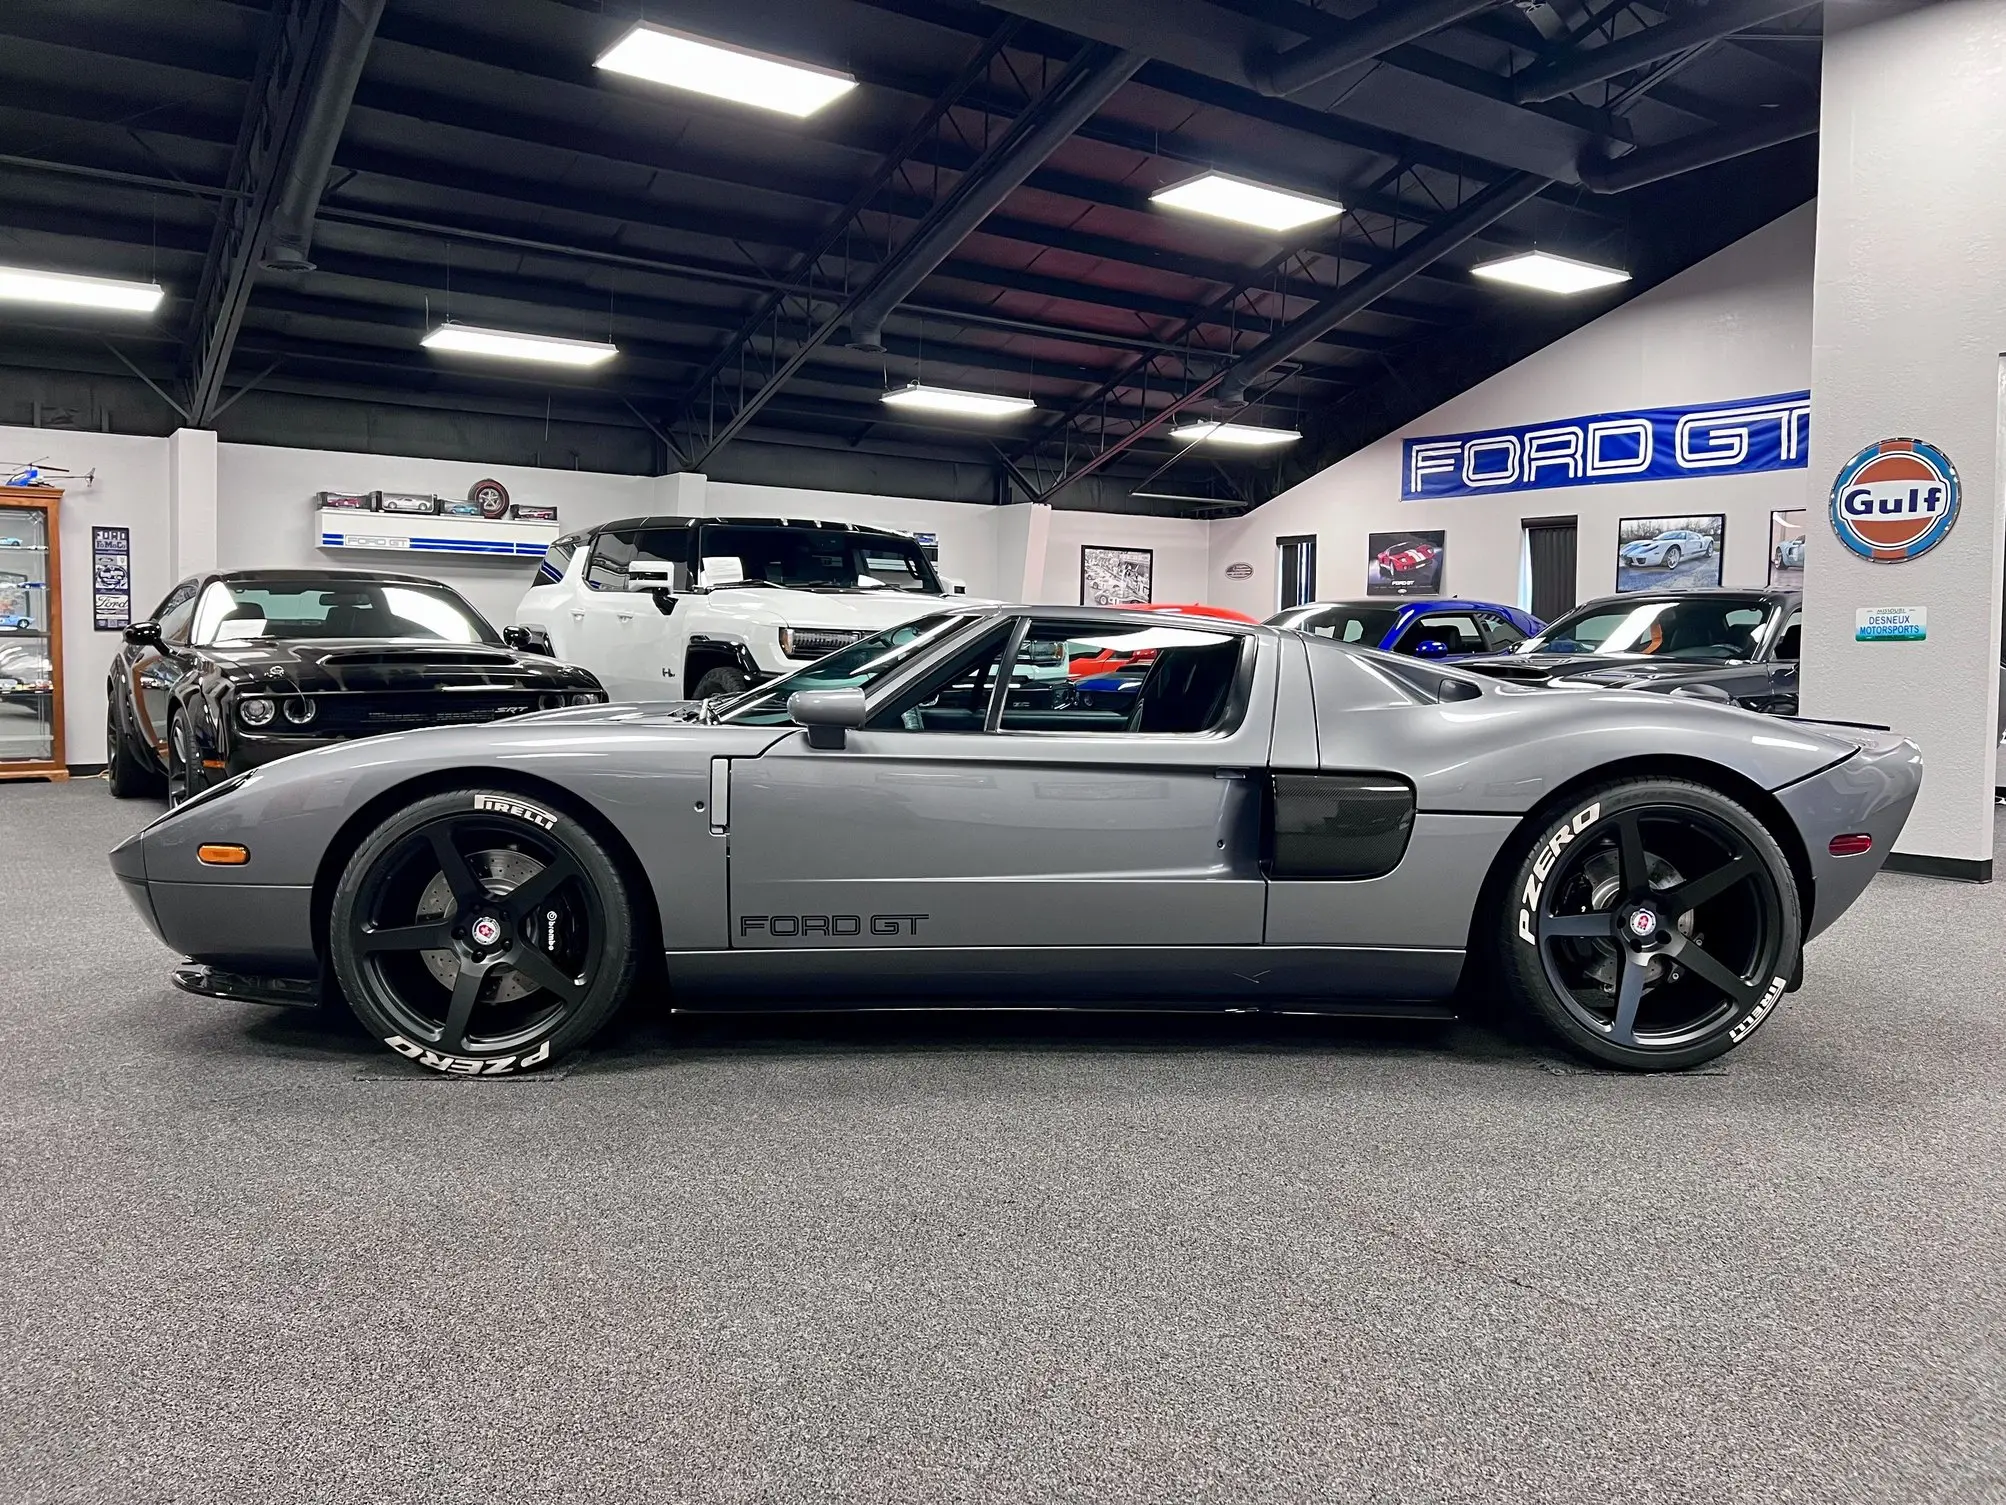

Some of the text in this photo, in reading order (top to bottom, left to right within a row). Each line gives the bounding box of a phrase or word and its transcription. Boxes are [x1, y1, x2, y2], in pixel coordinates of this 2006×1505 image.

[1411, 399, 1811, 493] FORD GT
[1844, 487, 1942, 516] Gulf
[347, 537, 409, 547] FORD GT
[96, 595, 129, 608] Ford
[1859, 624, 1920, 635] MOTORSPORTS
[1868, 615, 1910, 625] DESNEUX
[494, 706, 529, 714] SRT
[474, 794, 558, 830] PIRELLI
[547, 920, 556, 951] brembo
[740, 914, 930, 937] FORD GT
[1728, 976, 1787, 1043] PIRELLI
